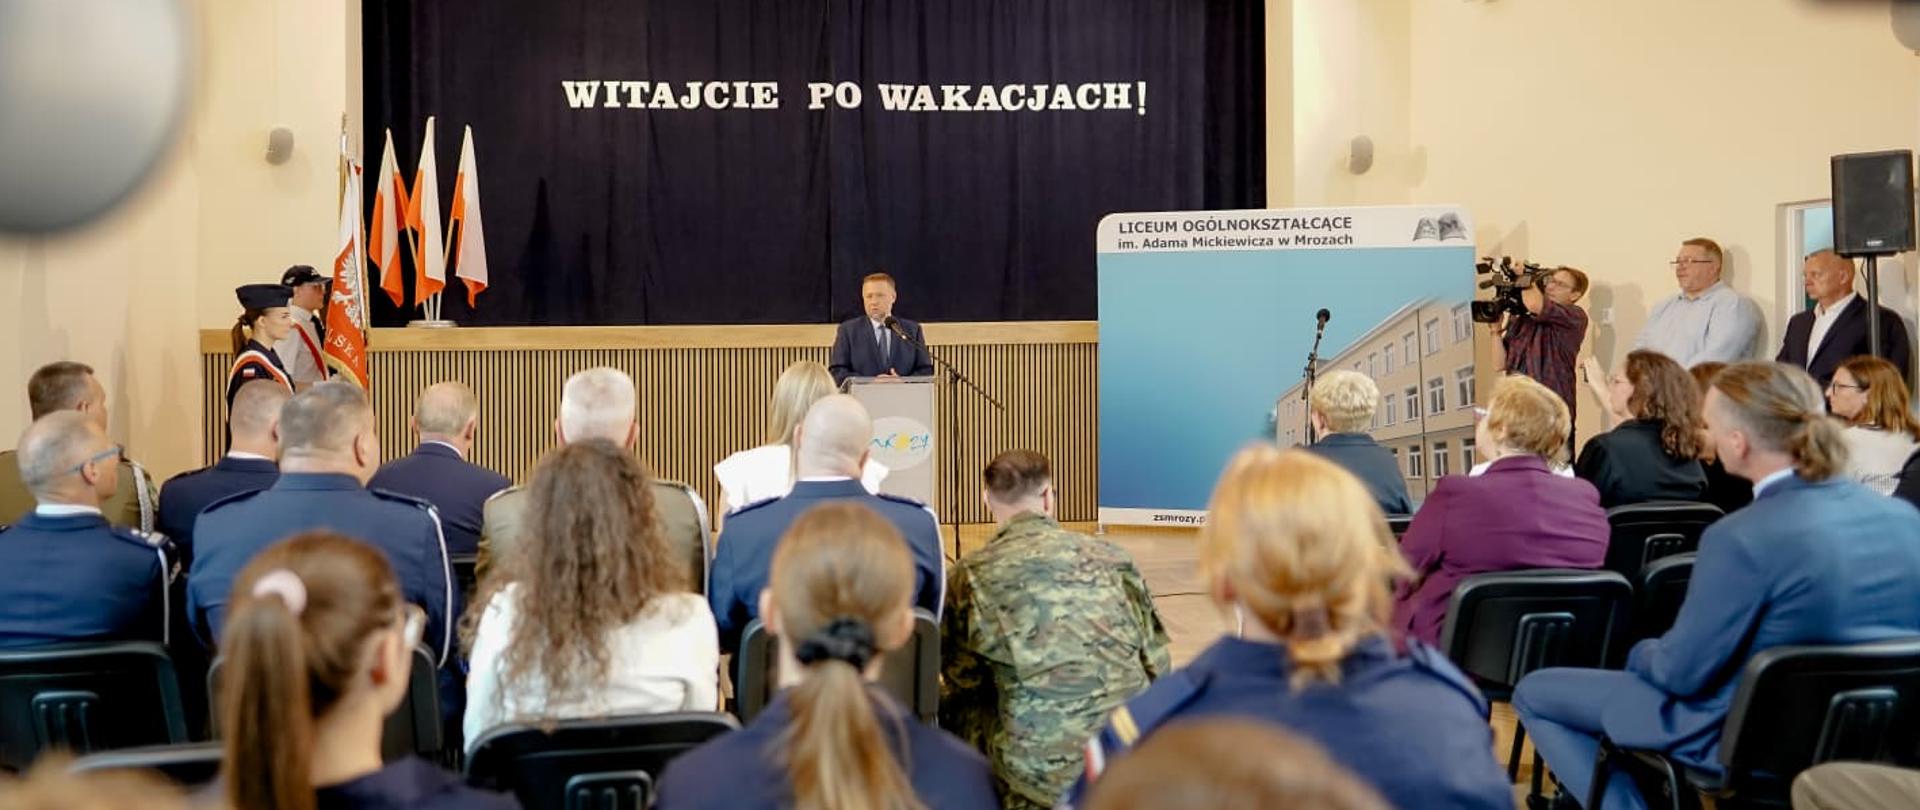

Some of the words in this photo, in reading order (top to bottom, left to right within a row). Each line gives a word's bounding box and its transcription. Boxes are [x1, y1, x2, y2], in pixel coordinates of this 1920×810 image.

[562, 80, 779, 109] WITAJCIE
[808, 82, 862, 109] PO
[877, 82, 1148, 115] WAKACJACH!
[1119, 221, 1178, 233] LICEUM
[1183, 215, 1353, 232] OGÓLNOKSZTAŁCĄCE
[1118, 238, 1139, 249] im.
[1143, 238, 1188, 248] Adama
[1192, 234, 1274, 247] Mickiewicza
[1278, 237, 1290, 246] w
[1295, 234, 1354, 246] Mrozach
[1153, 514, 1207, 524] zsmrozy.p
